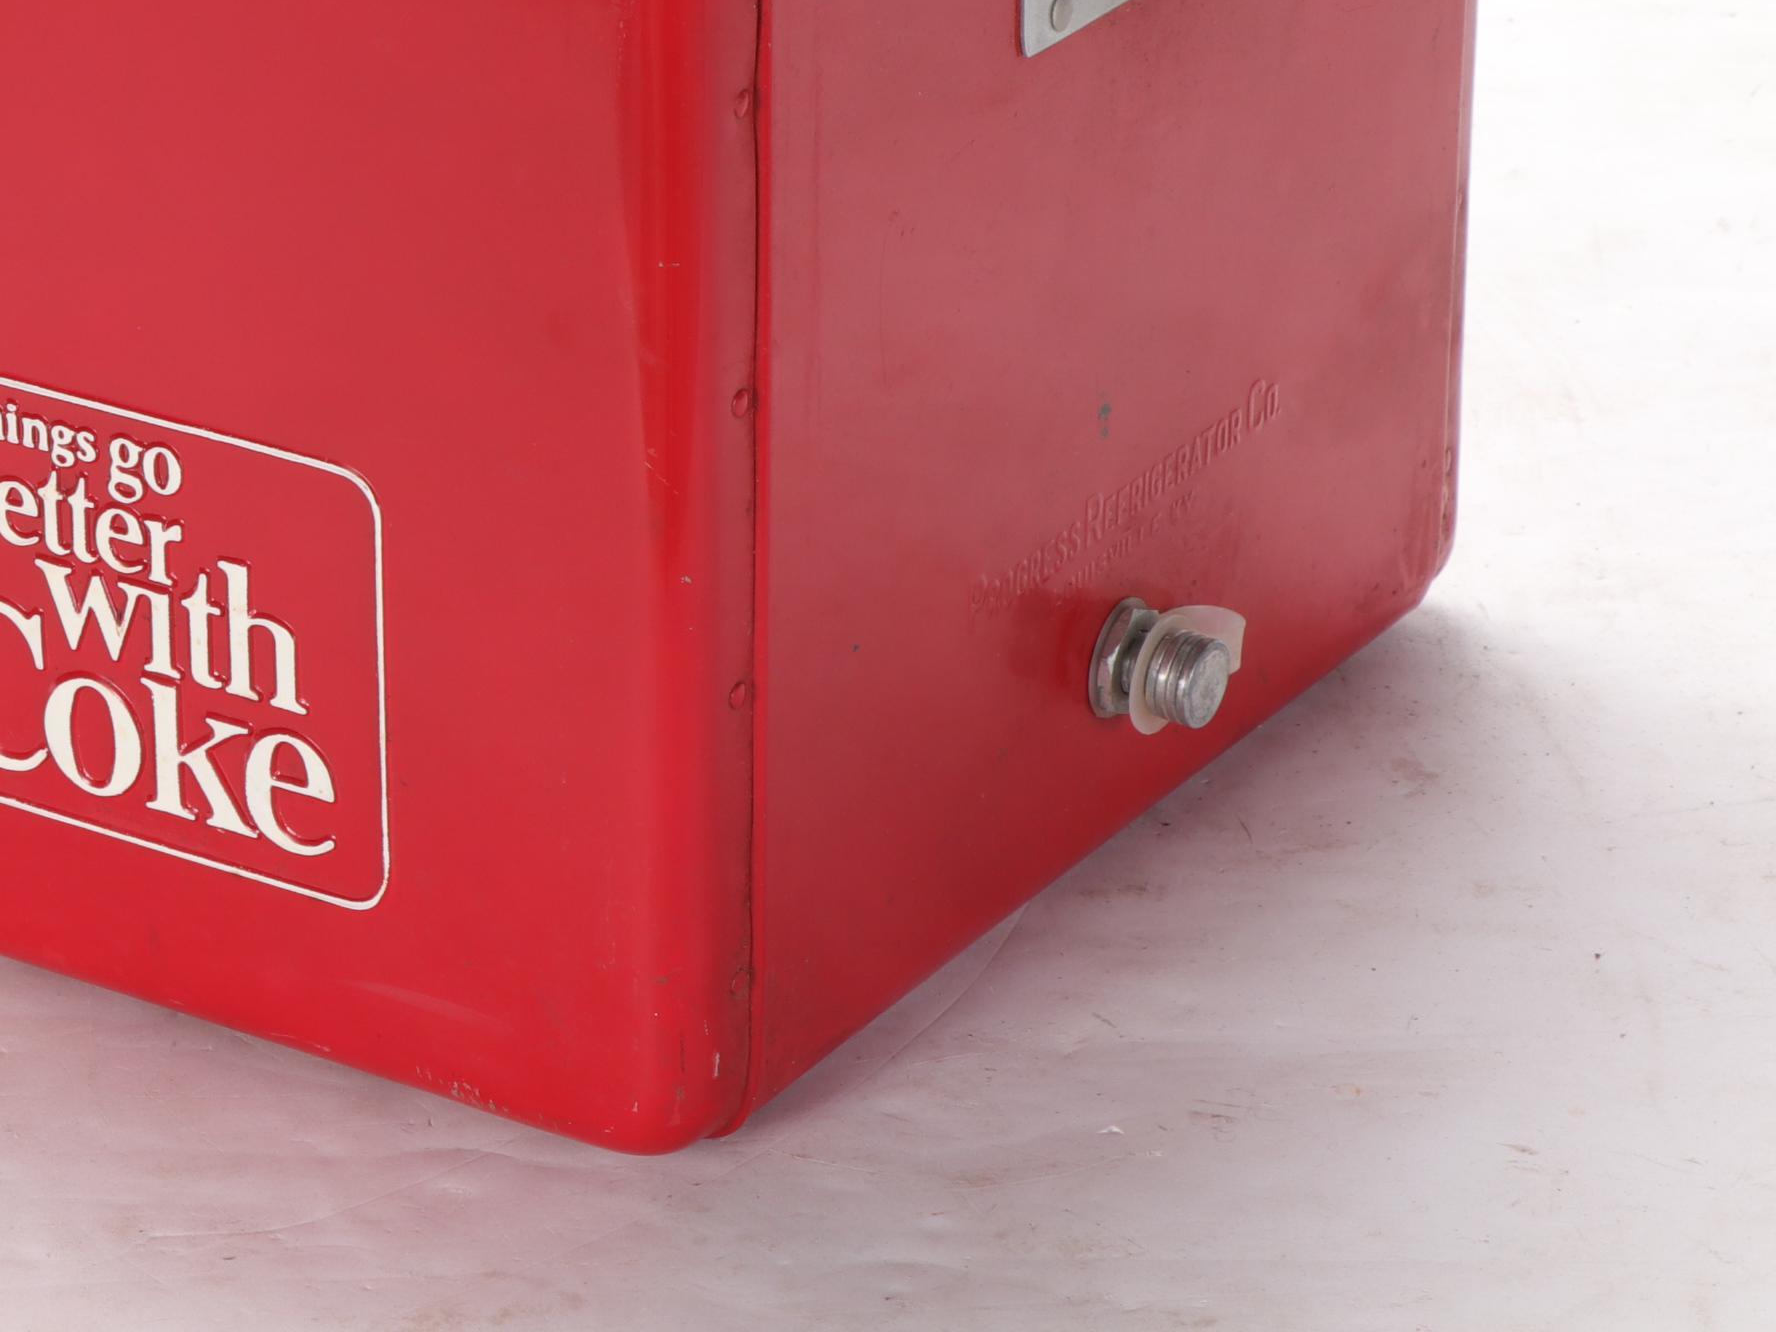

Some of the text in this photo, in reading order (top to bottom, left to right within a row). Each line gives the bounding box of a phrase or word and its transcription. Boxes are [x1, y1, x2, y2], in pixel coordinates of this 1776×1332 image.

[109, 435, 181, 503] go
[1084, 408, 1243, 549] REFRIGERATOR
[35, 556, 310, 716] with
